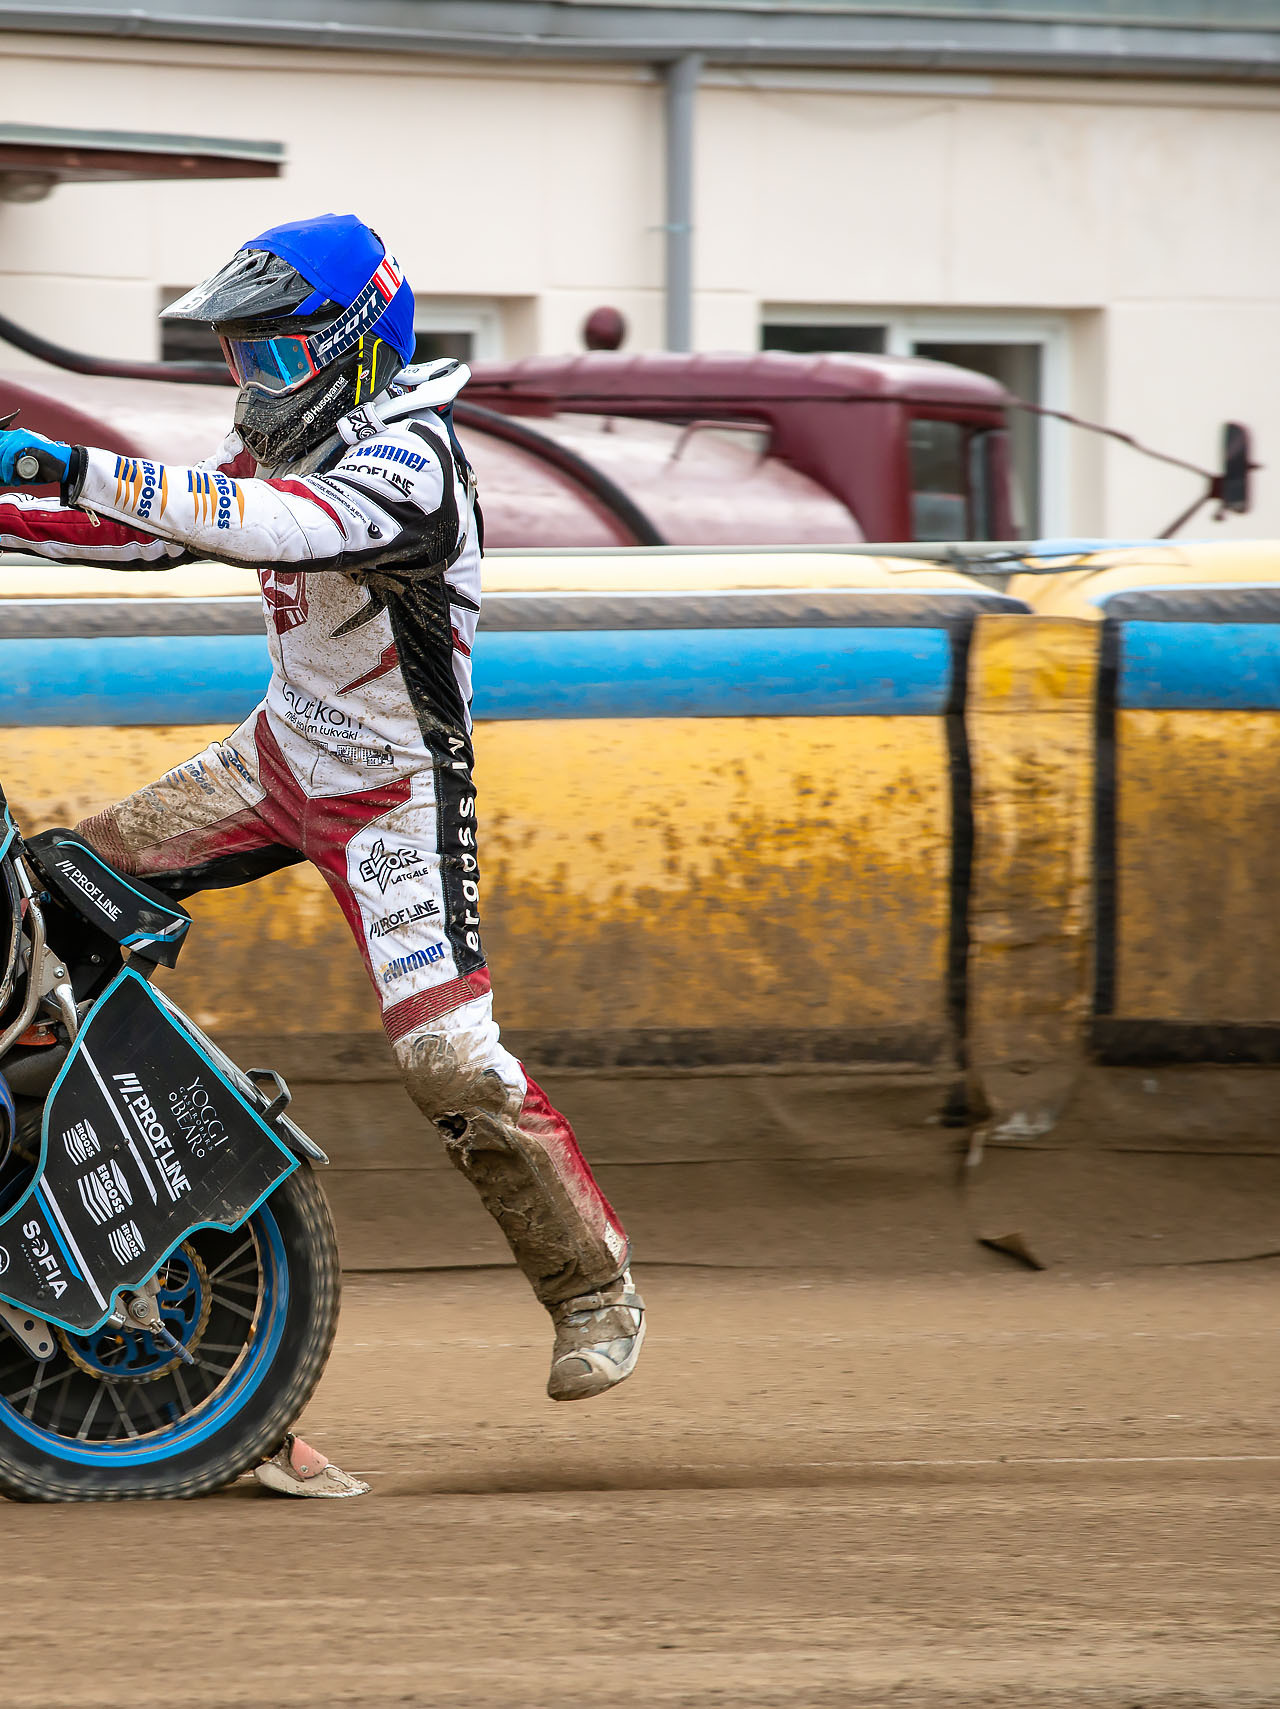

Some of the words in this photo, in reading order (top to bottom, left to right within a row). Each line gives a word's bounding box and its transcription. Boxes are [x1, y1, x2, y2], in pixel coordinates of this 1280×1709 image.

[317, 290, 377, 357] SCOTT
[311, 376, 345, 417] Husqvarna
[137, 460, 156, 519] ERGOSS
[212, 474, 232, 530] ERGOSS
[69, 868, 123, 920] PROFLINE
[391, 867, 428, 884] LATGALE
[170, 1099, 203, 1154] BEAR
[179, 1086, 214, 1151] GASTROBARS
[186, 1076, 229, 1147] YOGGI
[75, 1122, 96, 1158] ERGOSS
[132, 1093, 192, 1199] PROFLINE
[96, 1163, 125, 1214] ERGOSS
[22, 1220, 68, 1300] SOFIA
[120, 1223, 141, 1258] ERGOSS
